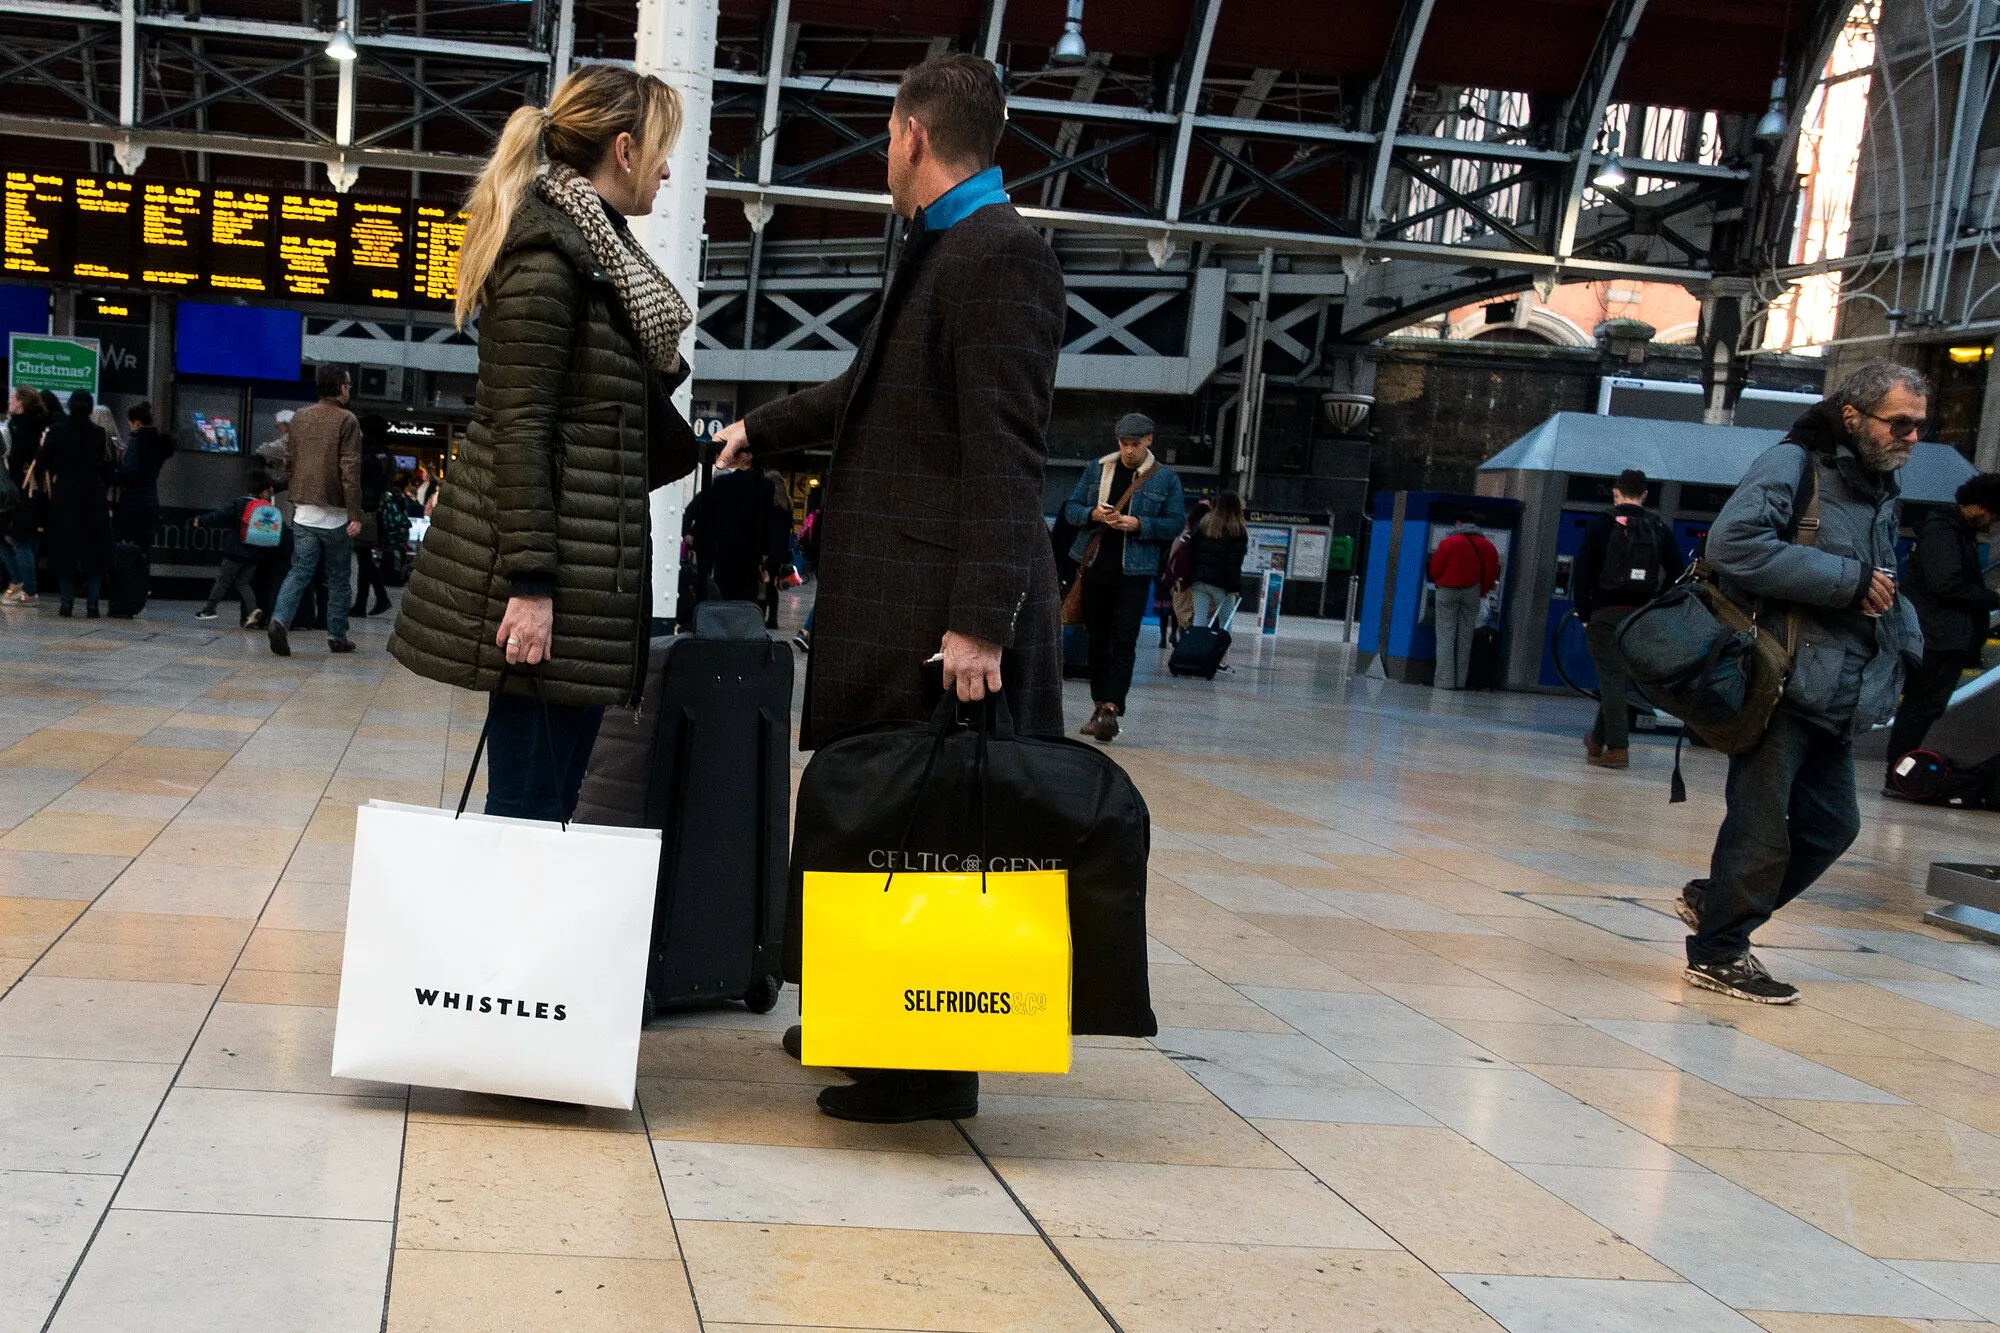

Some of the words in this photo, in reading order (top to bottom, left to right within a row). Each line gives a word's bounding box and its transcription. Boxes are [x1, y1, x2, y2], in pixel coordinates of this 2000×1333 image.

[16, 361, 92, 377] Christmas?
[1261, 511, 1310, 524] Information
[868, 849, 959, 872] CELTIC
[415, 987, 567, 1021] WHISTLES
